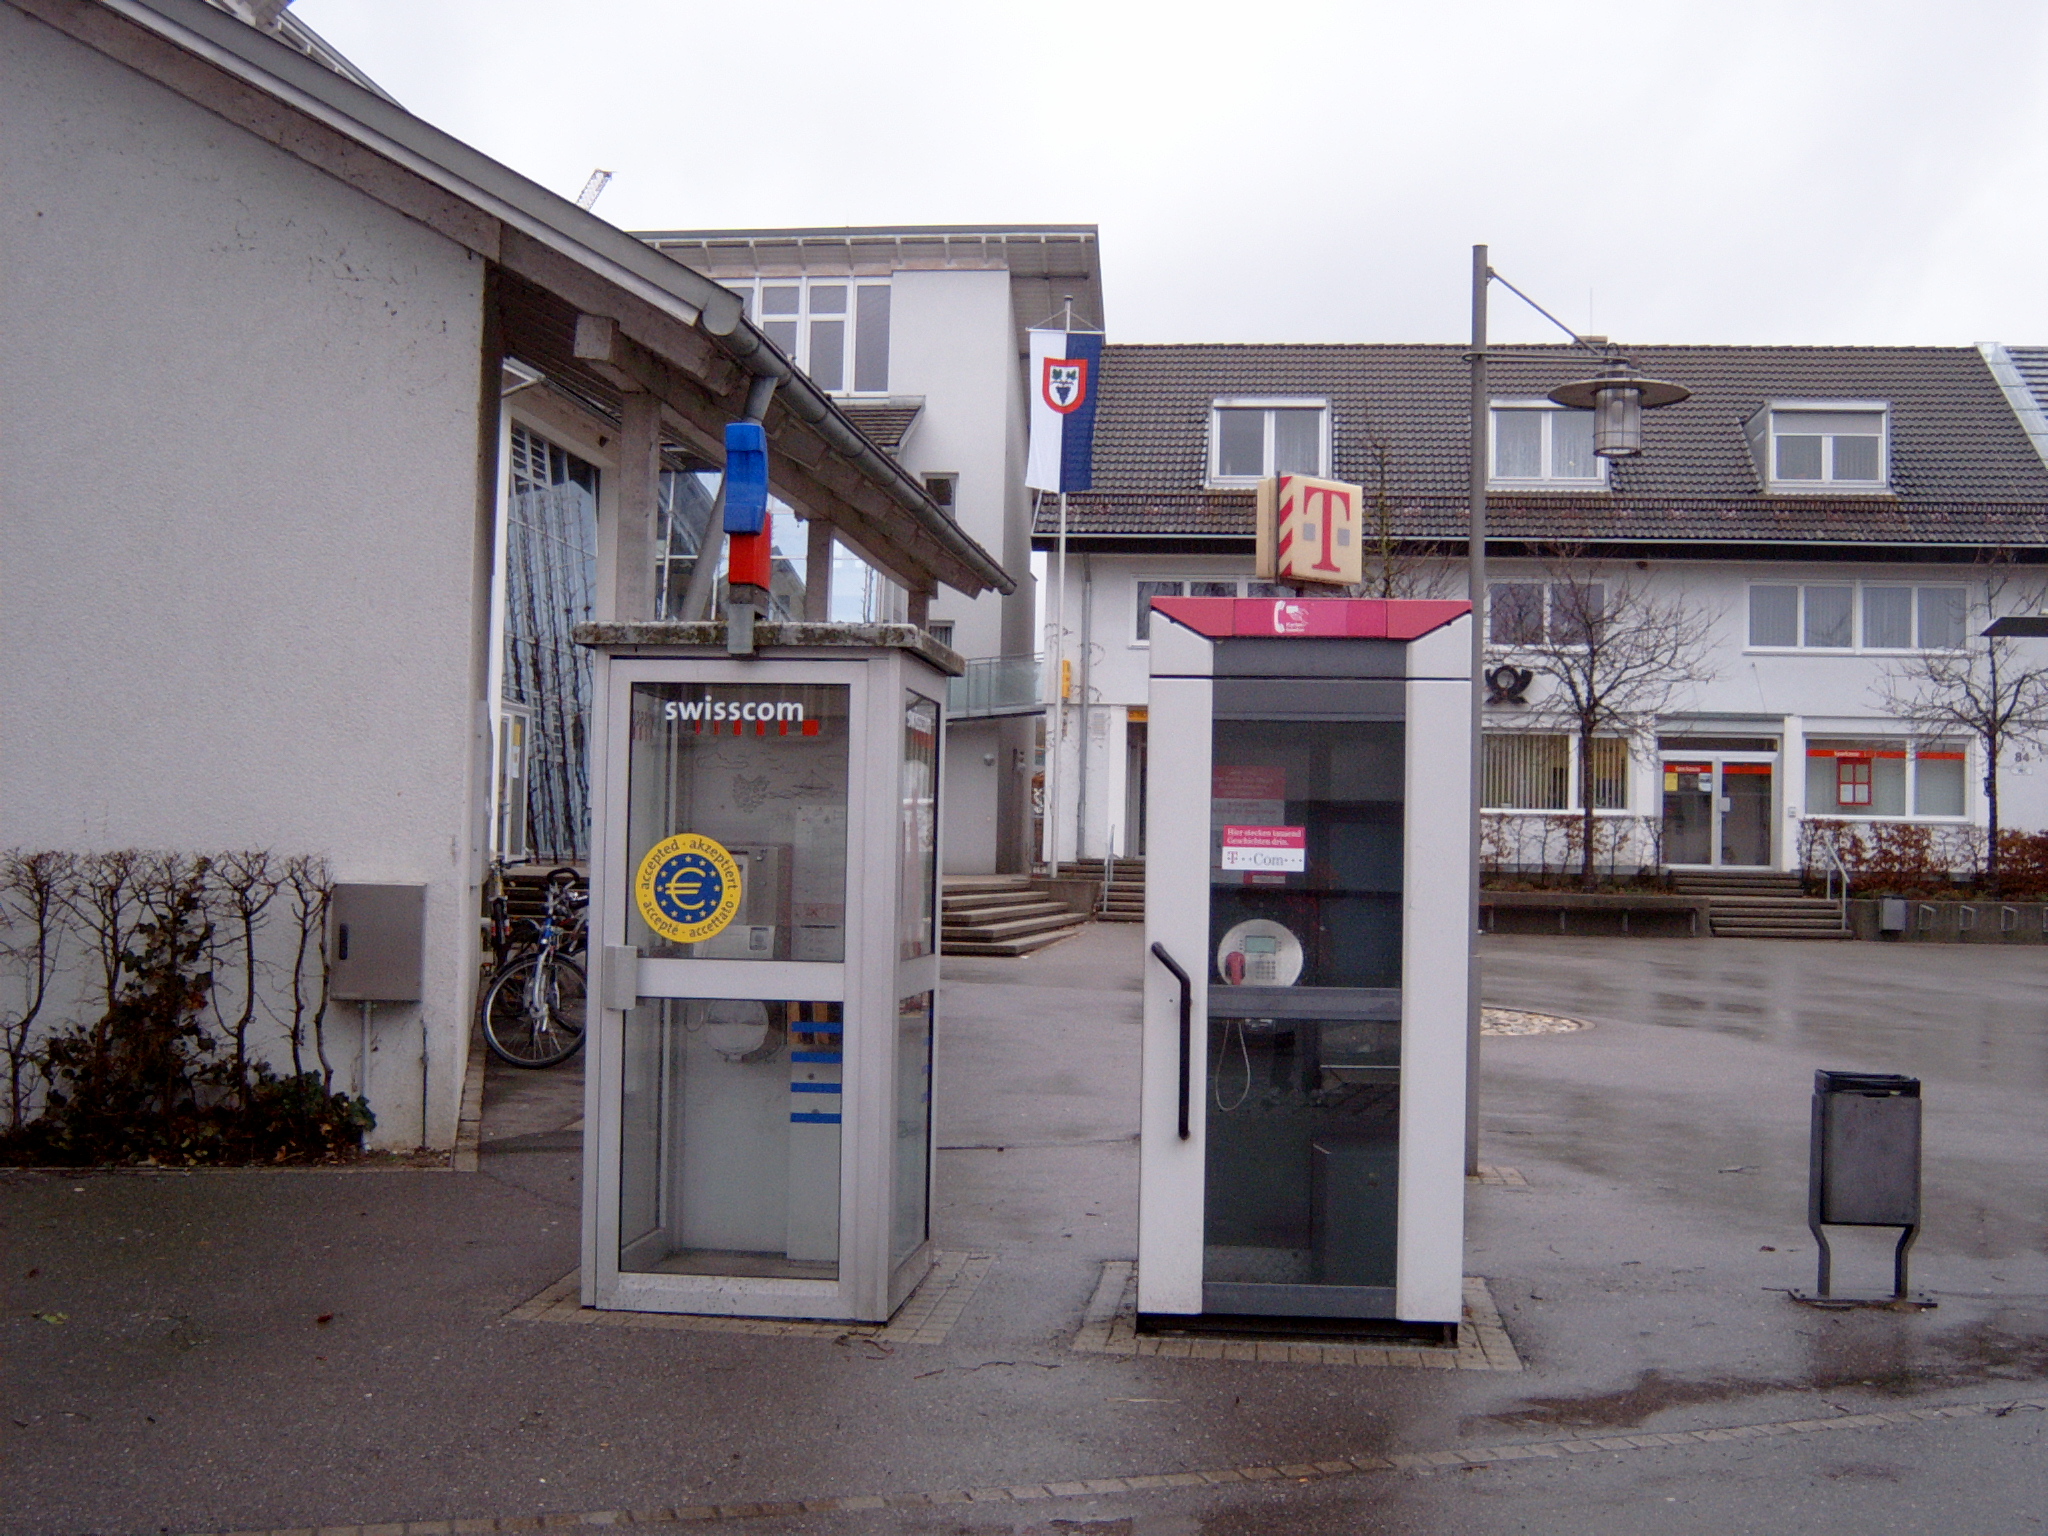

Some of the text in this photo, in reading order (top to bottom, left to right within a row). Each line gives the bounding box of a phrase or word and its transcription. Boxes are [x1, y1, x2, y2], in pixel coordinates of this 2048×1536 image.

[1303, 485, 1351, 573] T
[664, 694, 804, 722] swisscom
[2015, 751, 2030, 763] 84
[1226, 836, 1271, 846] Geschichten
[1227, 827, 1244, 837] Hier
[641, 838, 681, 890] accepted
[689, 838, 739, 890] akzeptiert
[643, 901, 679, 936] accepté
[689, 900, 735, 938] accettato
